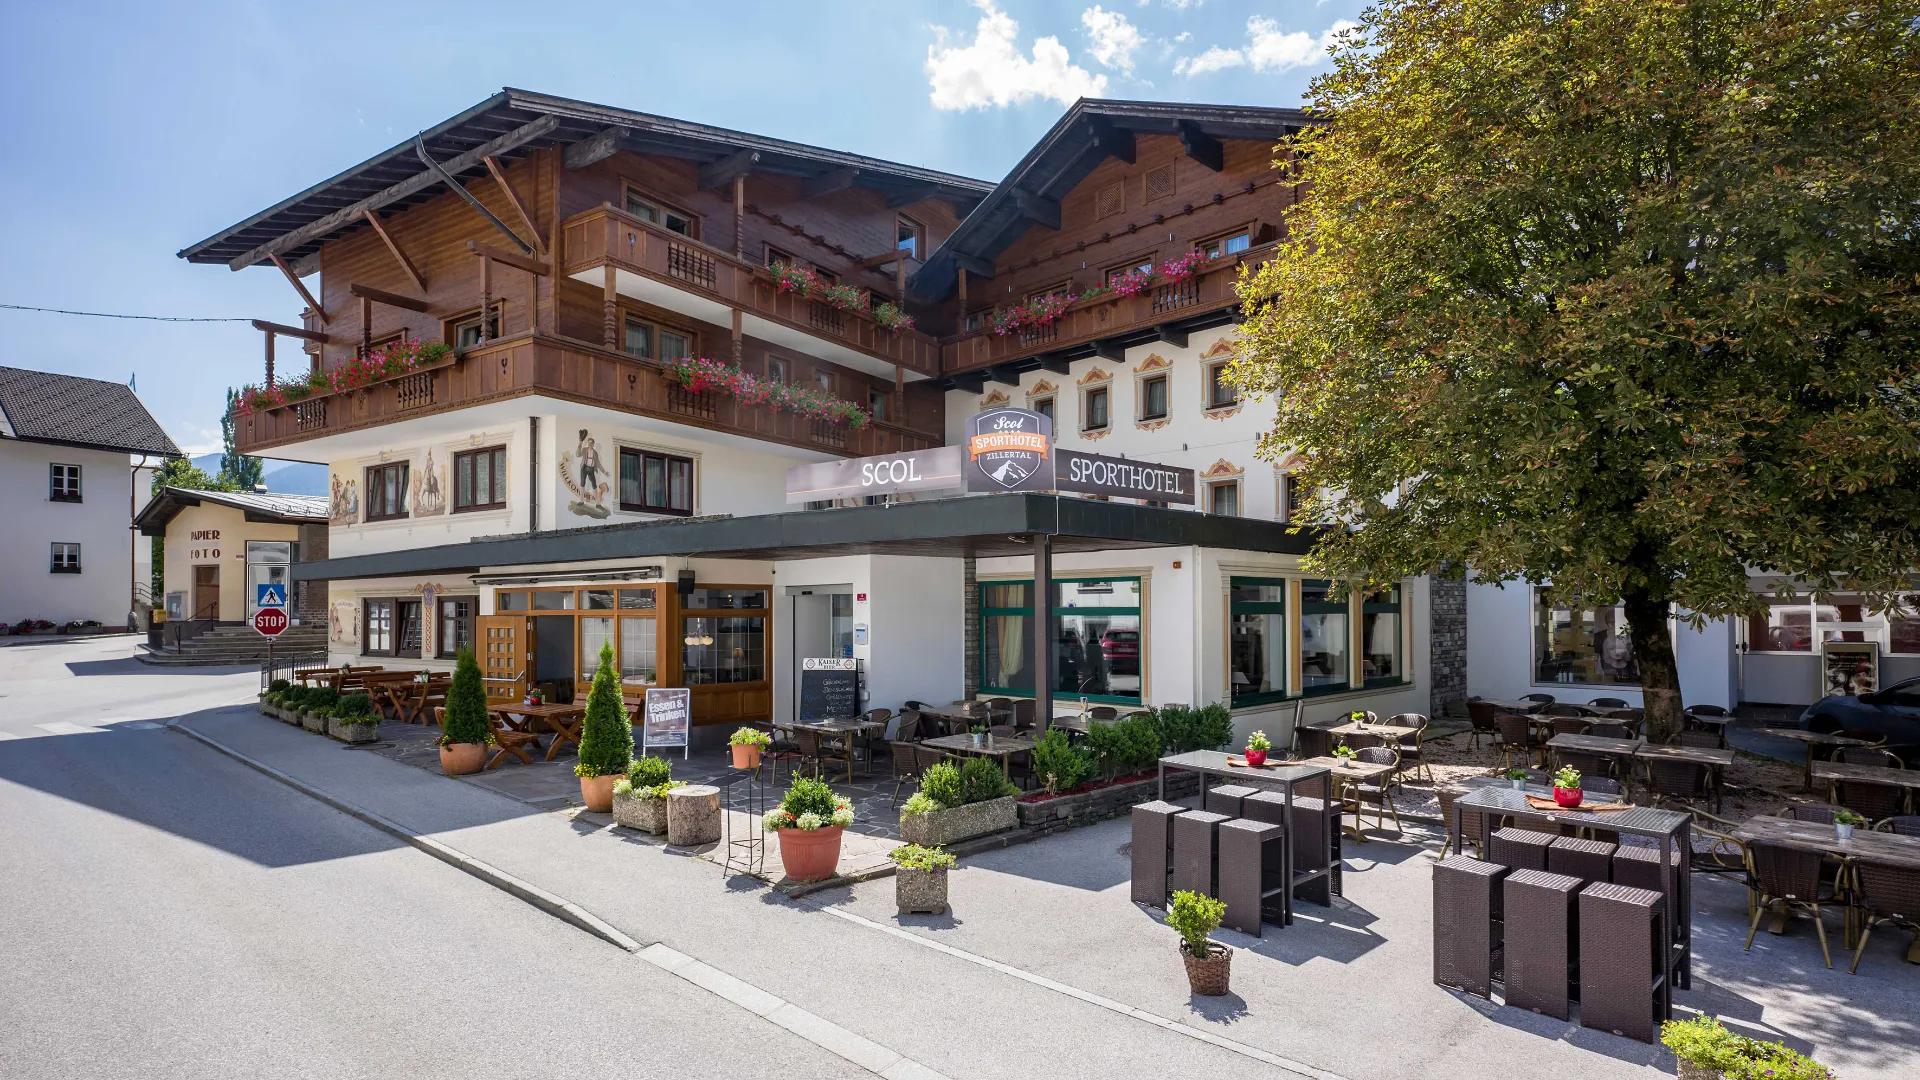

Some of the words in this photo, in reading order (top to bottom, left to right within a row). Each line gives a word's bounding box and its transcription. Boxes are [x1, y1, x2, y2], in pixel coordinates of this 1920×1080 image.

[993, 416, 1024, 429] Scol
[976, 435, 1042, 449] SPORTHOTEL
[986, 451, 1032, 460] ZILLERTAL
[862, 458, 922, 487] SCOL
[1070, 457, 1184, 495] SPORTHOTEL
[190, 530, 220, 541] PAPIER
[190, 548, 220, 559] FOTO
[257, 616, 285, 627] STOP
[818, 659, 841, 667] KAISER
[649, 700, 677, 714] Essen
[677, 699, 685, 709] &
[649, 708, 686, 724] Trinken
